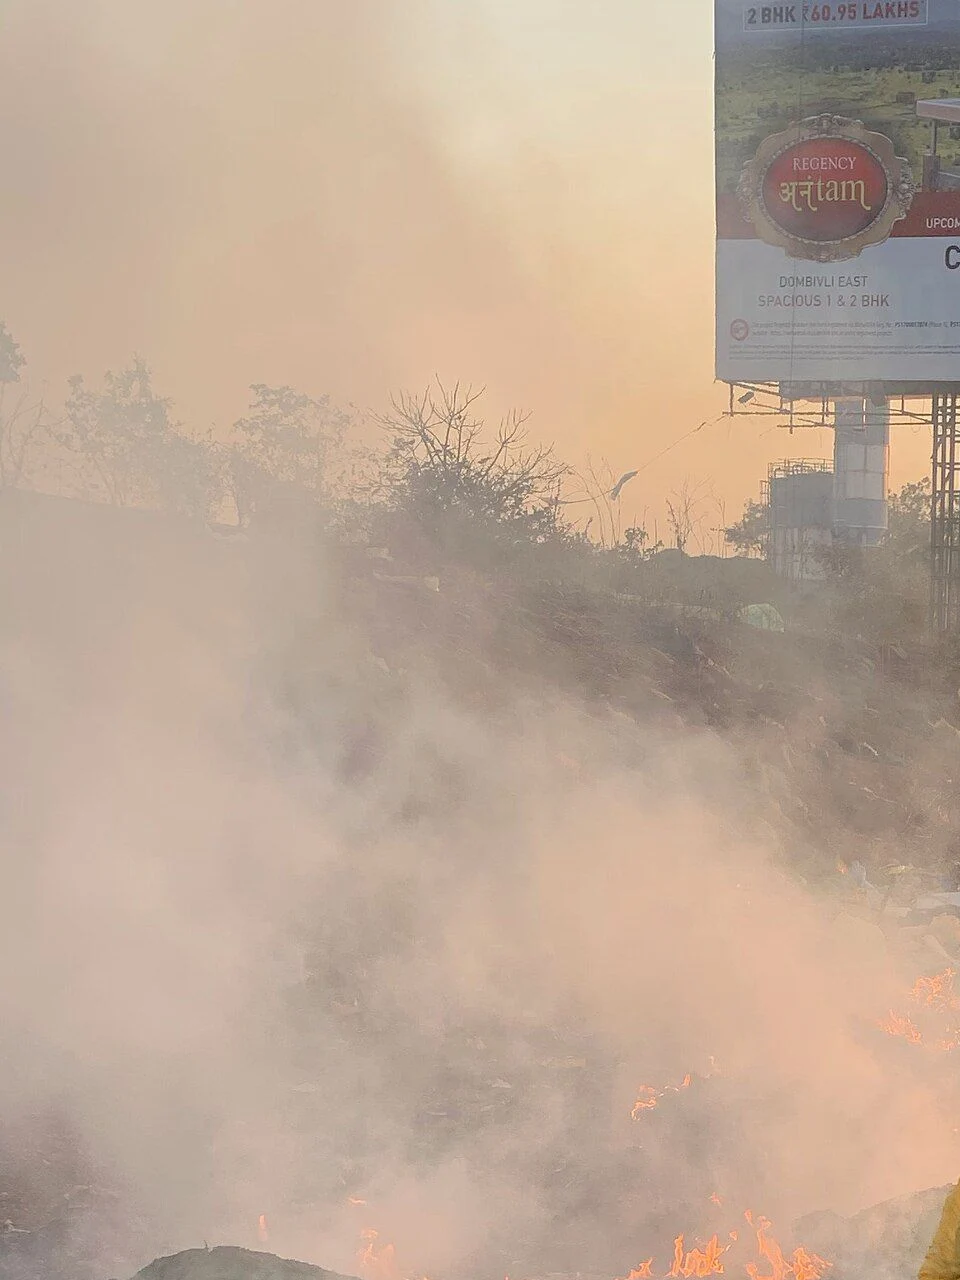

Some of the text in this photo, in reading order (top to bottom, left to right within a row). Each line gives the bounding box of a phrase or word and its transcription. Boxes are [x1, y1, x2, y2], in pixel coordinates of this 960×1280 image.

[747, 8, 757, 24] 2
[761, 6, 796, 23] BHK
[793, 157, 857, 171] REGENCY
[779, 276, 868, 288] DOMBIVLI EAST
[758, 295, 890, 307] SPACIOUS 1 & 2 BHK
